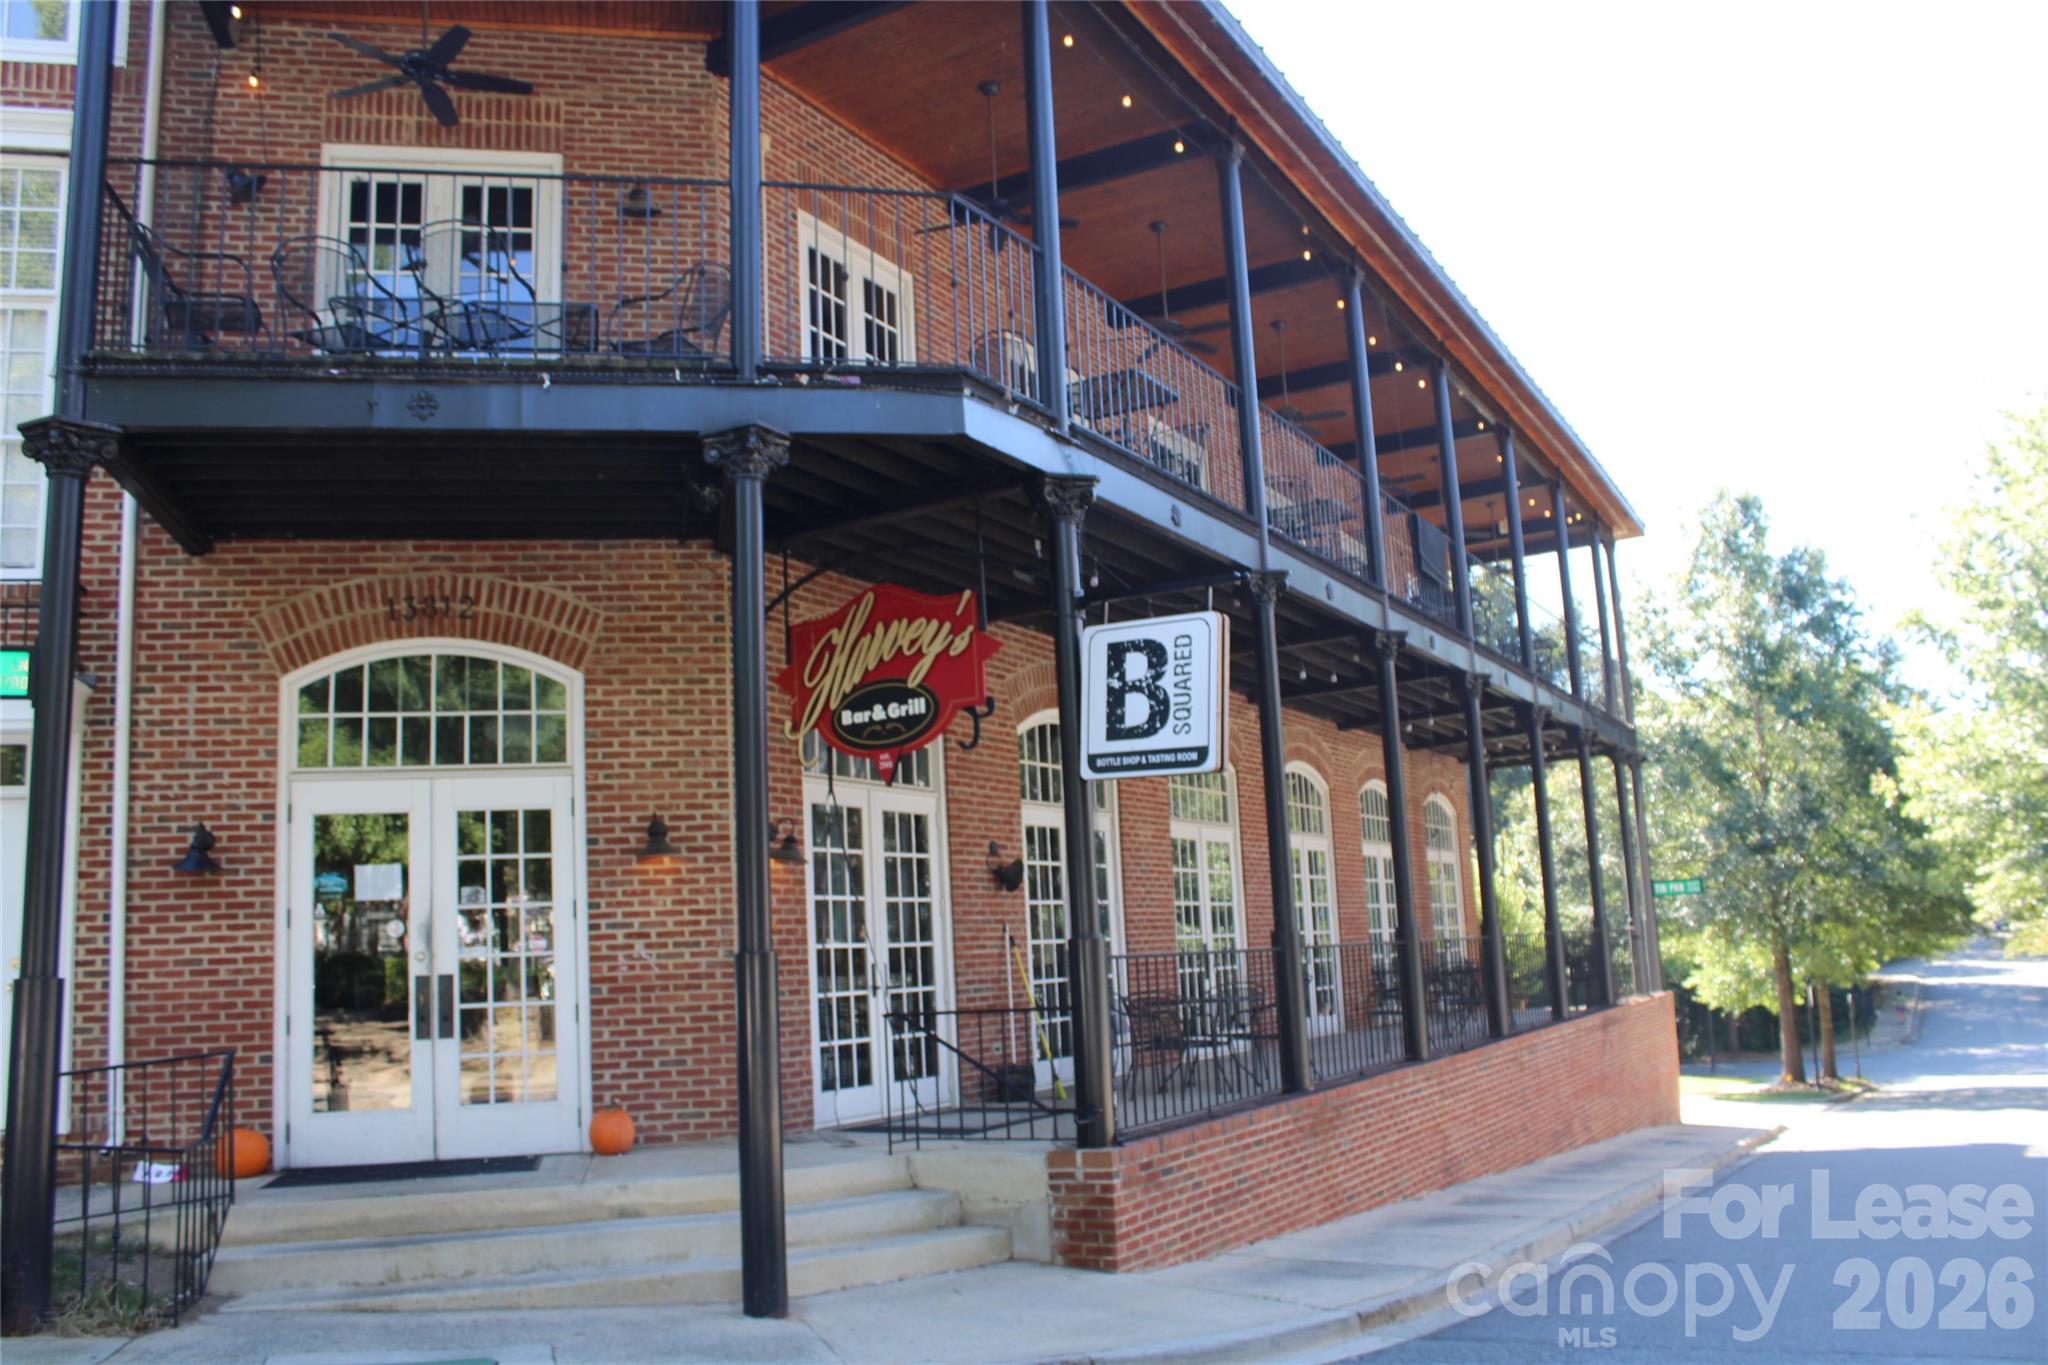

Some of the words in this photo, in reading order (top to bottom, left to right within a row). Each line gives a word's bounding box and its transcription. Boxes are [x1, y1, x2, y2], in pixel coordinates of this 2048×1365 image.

[387, 595, 475, 621] 13812
[785, 589, 974, 765] Harvey's
[1106, 638, 1170, 741] B
[1173, 634, 1192, 735] SQUARED
[1096, 758, 1121, 768] BOTTLE
[1123, 756, 1141, 765] SHOP
[1147, 753, 1176, 764] TASTING
[1177, 752, 1198, 762] ROOM
